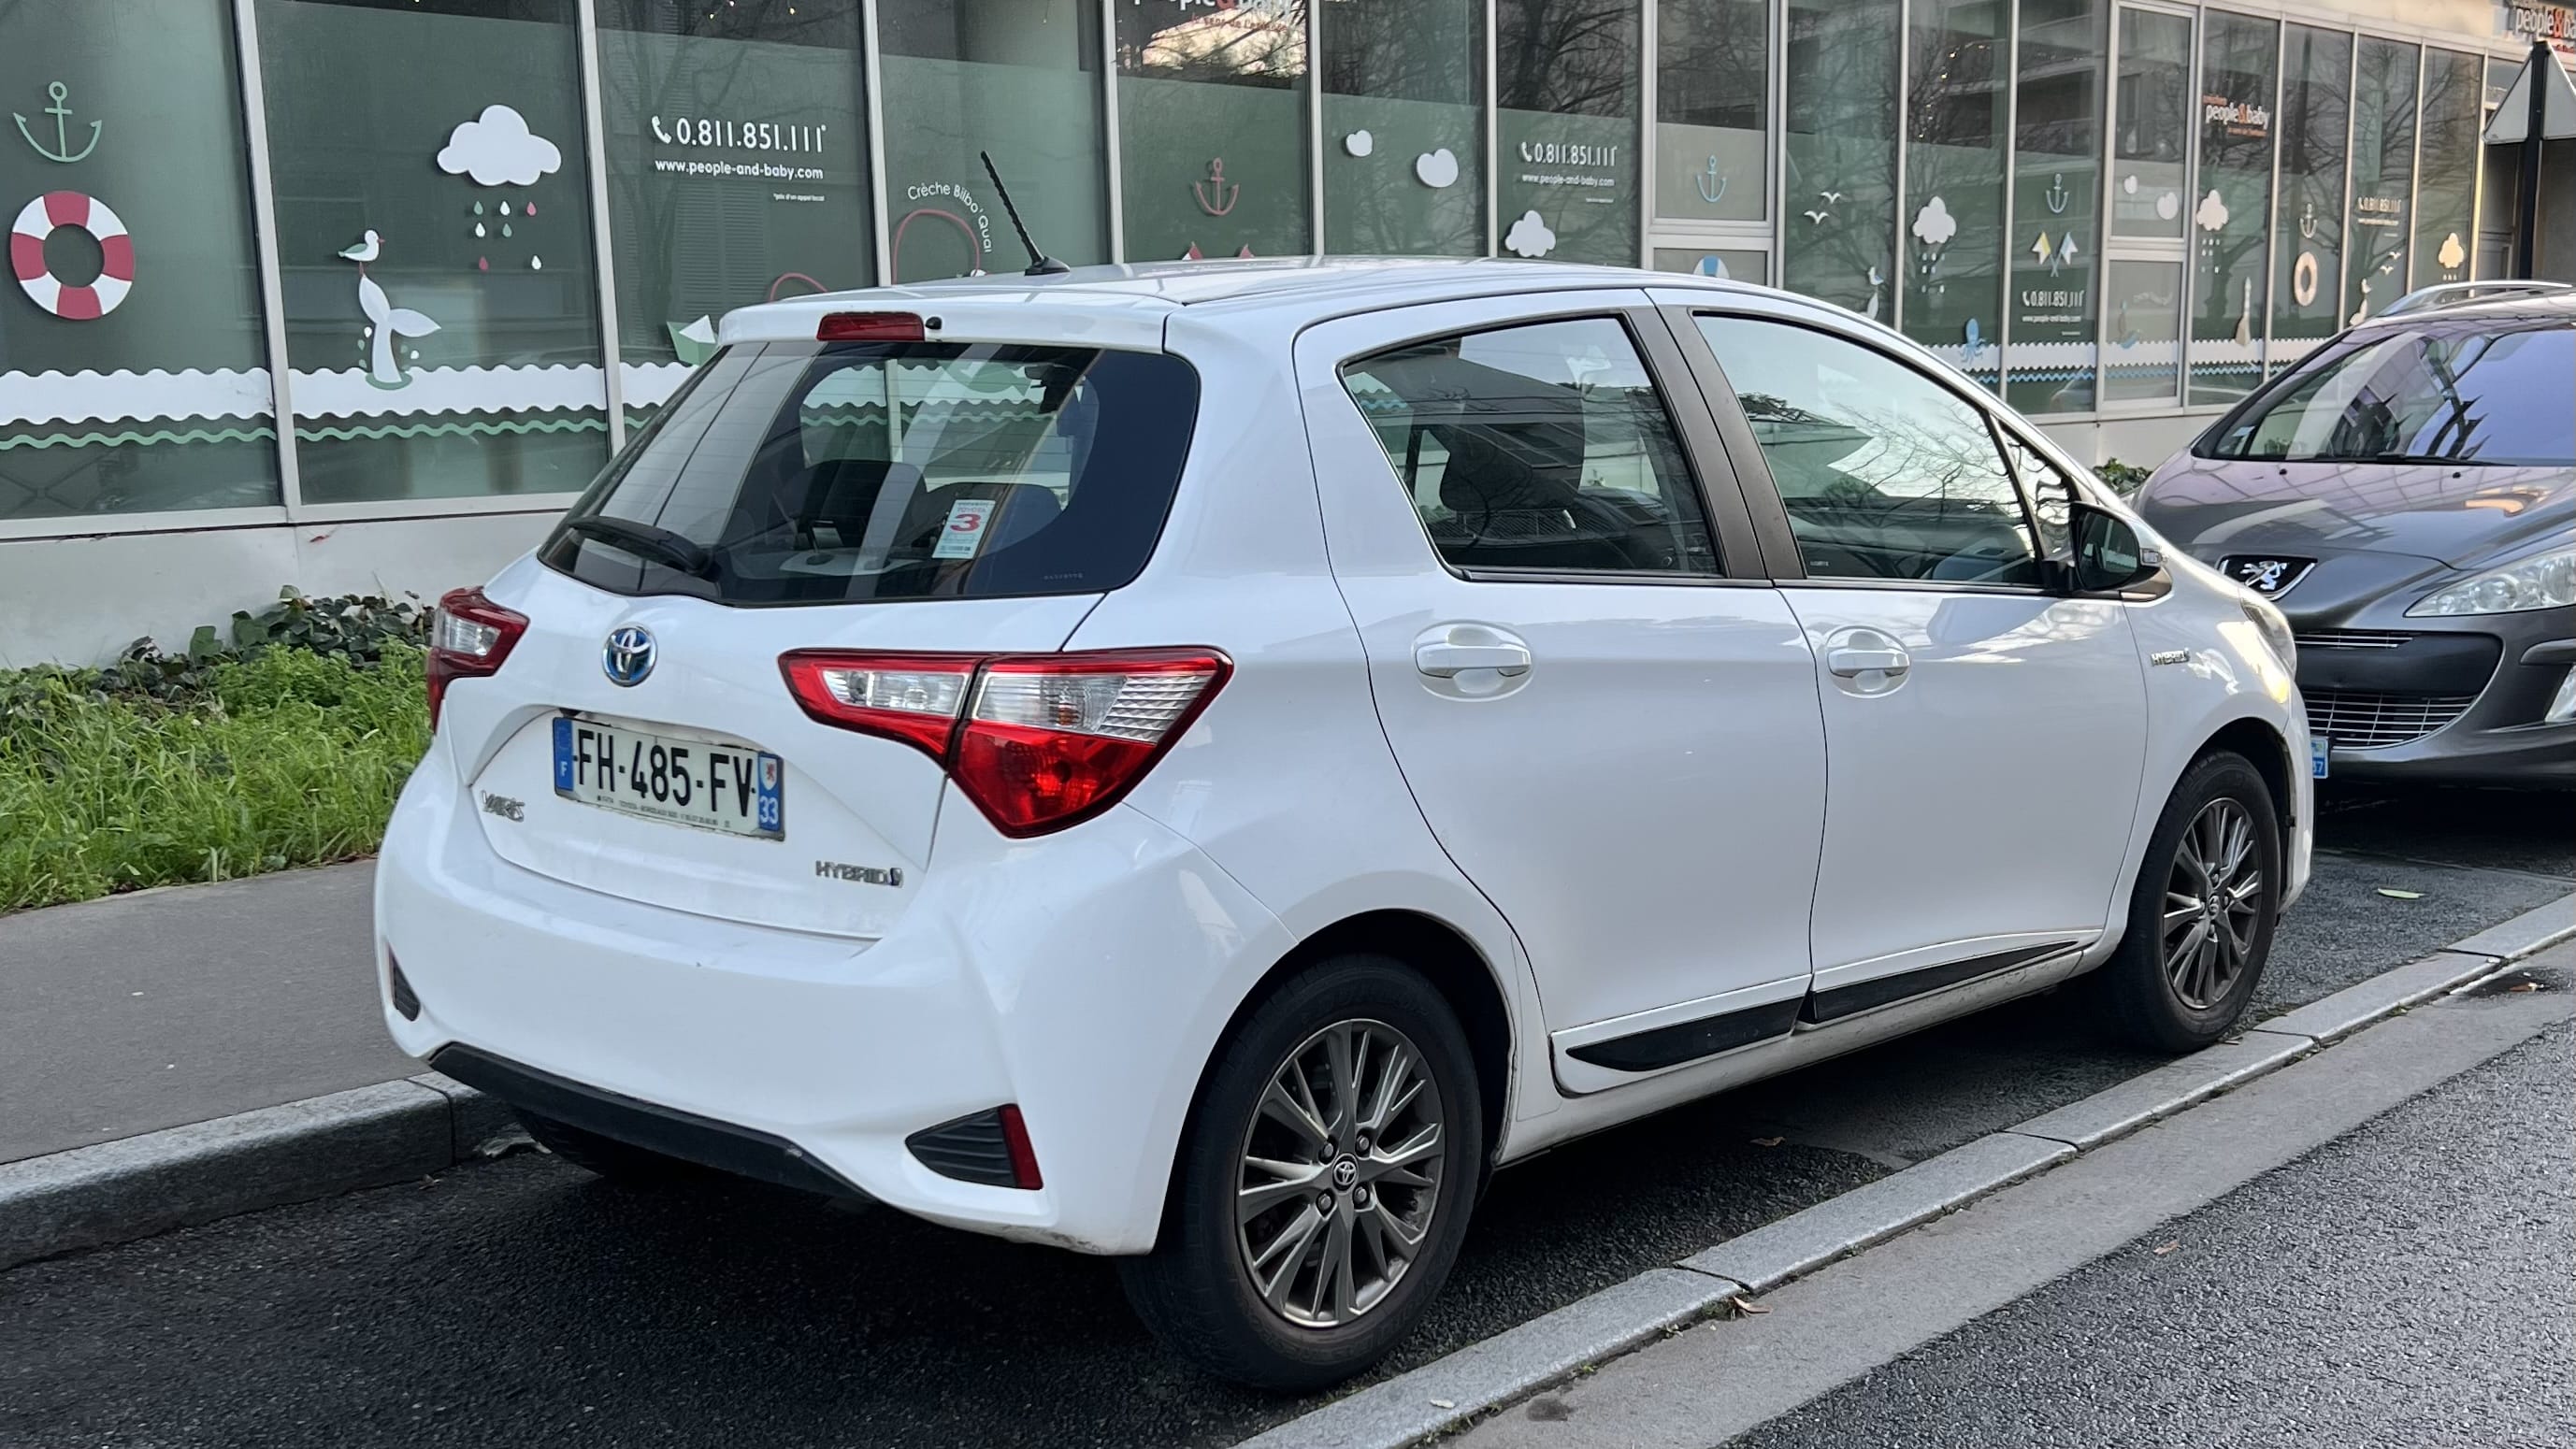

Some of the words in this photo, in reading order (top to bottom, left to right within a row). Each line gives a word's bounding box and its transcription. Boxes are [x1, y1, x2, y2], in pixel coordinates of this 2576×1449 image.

[655, 160, 824, 180] www.people-and-baby.com
[907, 180, 951, 200] Crèche
[950, 513, 982, 532] 3
[560, 761, 568, 777] F
[577, 728, 754, 817] FH-485-FV
[758, 796, 779, 825] 33
[815, 859, 889, 885] HYBRID
